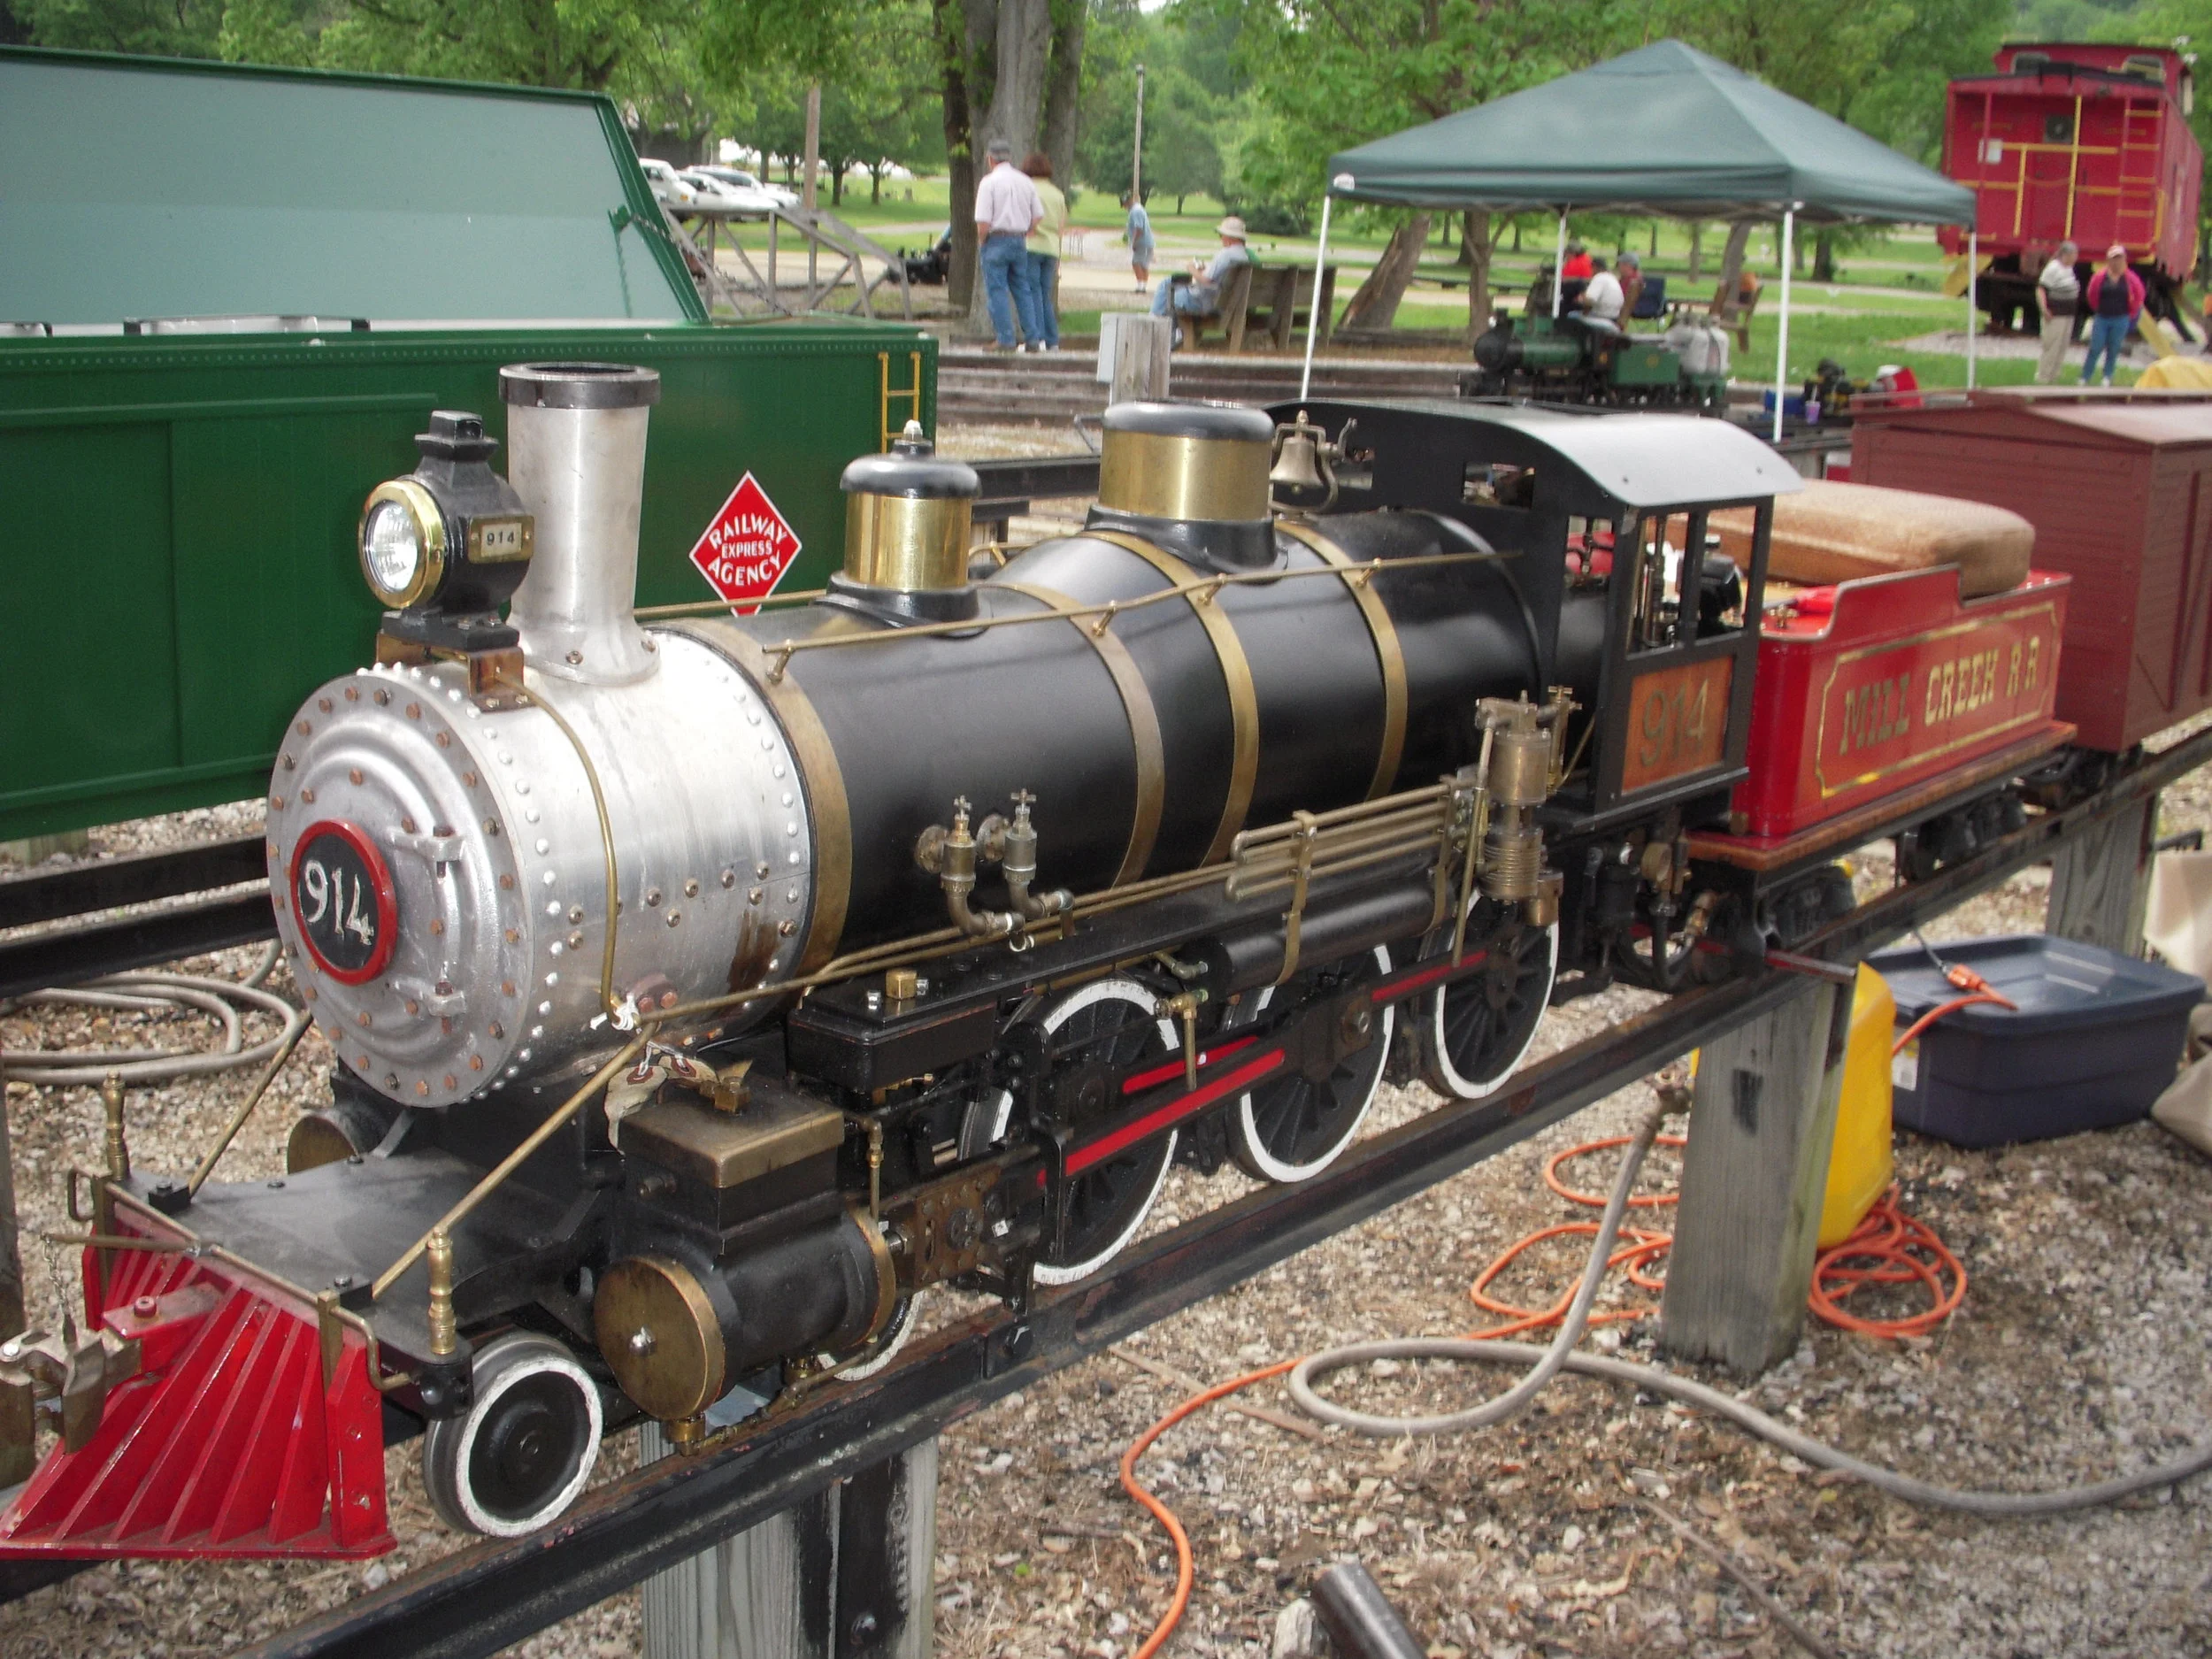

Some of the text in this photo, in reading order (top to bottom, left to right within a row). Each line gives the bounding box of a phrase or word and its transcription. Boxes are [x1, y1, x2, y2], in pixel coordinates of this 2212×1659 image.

[487, 532, 515, 545] 914
[709, 513, 787, 549] RAILWAY
[721, 540, 772, 558] EXPRESS
[708, 550, 781, 586] AGENCY
[1839, 672, 1910, 756] MILL
[1924, 649, 1999, 726] CREEK
[1640, 678, 1709, 767] 914
[304, 860, 374, 945] 914
